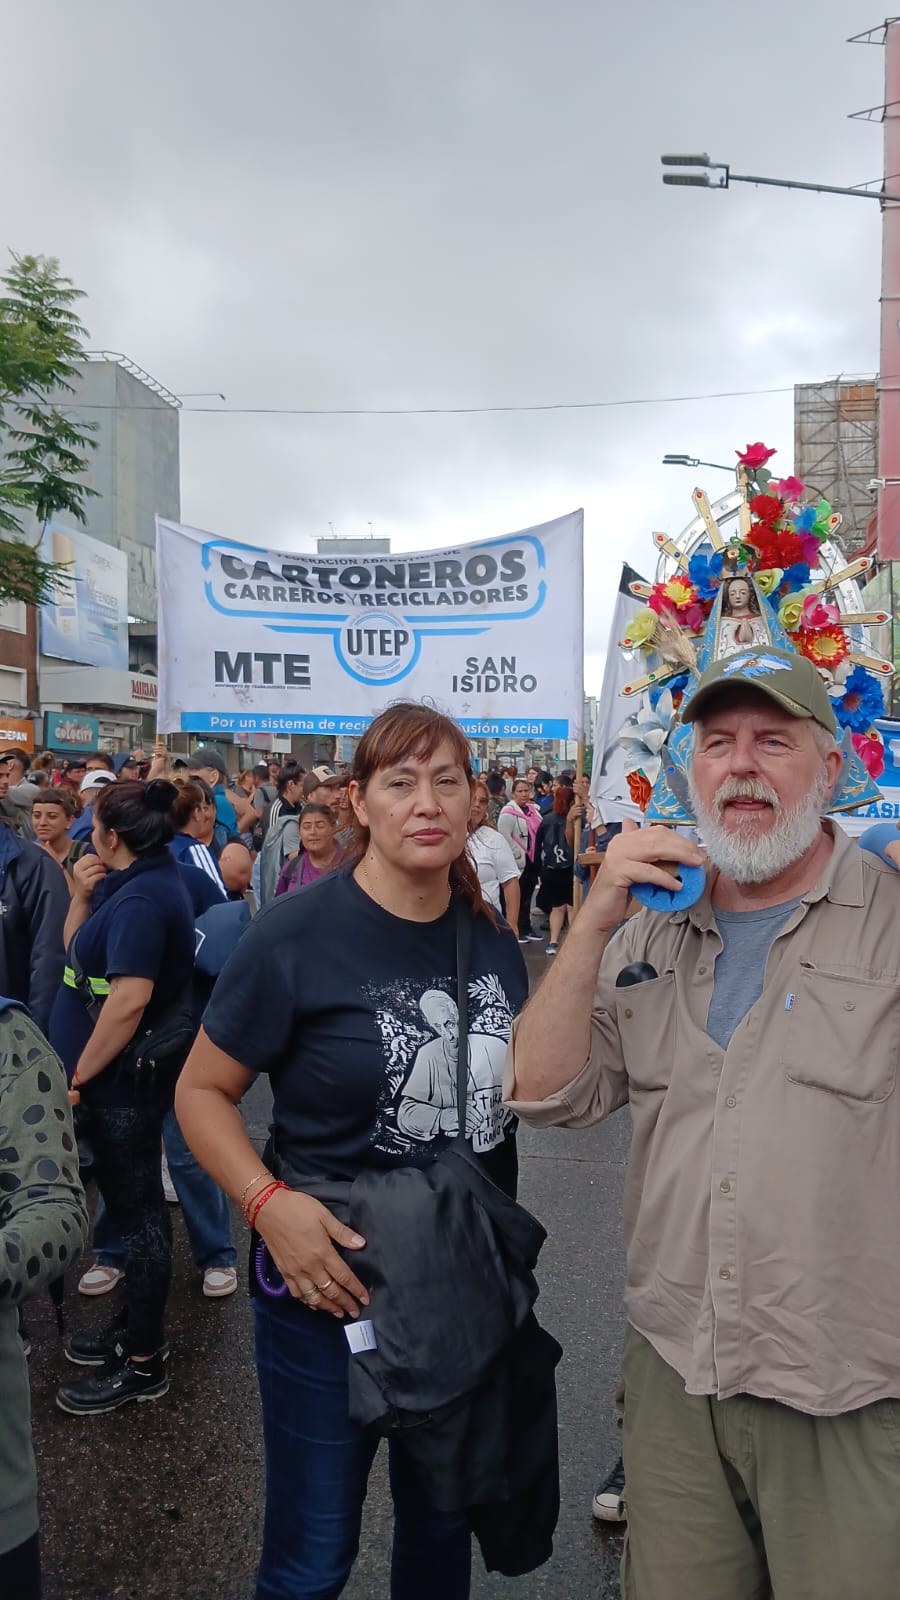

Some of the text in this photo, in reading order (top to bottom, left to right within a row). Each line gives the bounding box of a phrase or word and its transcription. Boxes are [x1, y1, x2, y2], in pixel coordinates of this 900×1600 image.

[220, 549, 526, 591] CARTONEROS
[223, 582, 528, 607] CARREROS Y RECICLADORES
[347, 628, 409, 656] UTEP
[214, 651, 311, 685] MTE
[465, 656, 516, 674] SAN
[452, 674, 537, 693] ISIDRO
[210, 717, 234, 728] Por
[239, 720, 256, 728] un
[260, 718, 314, 730] sistema
[318, 719, 336, 730] de
[503, 722, 543, 734] social
